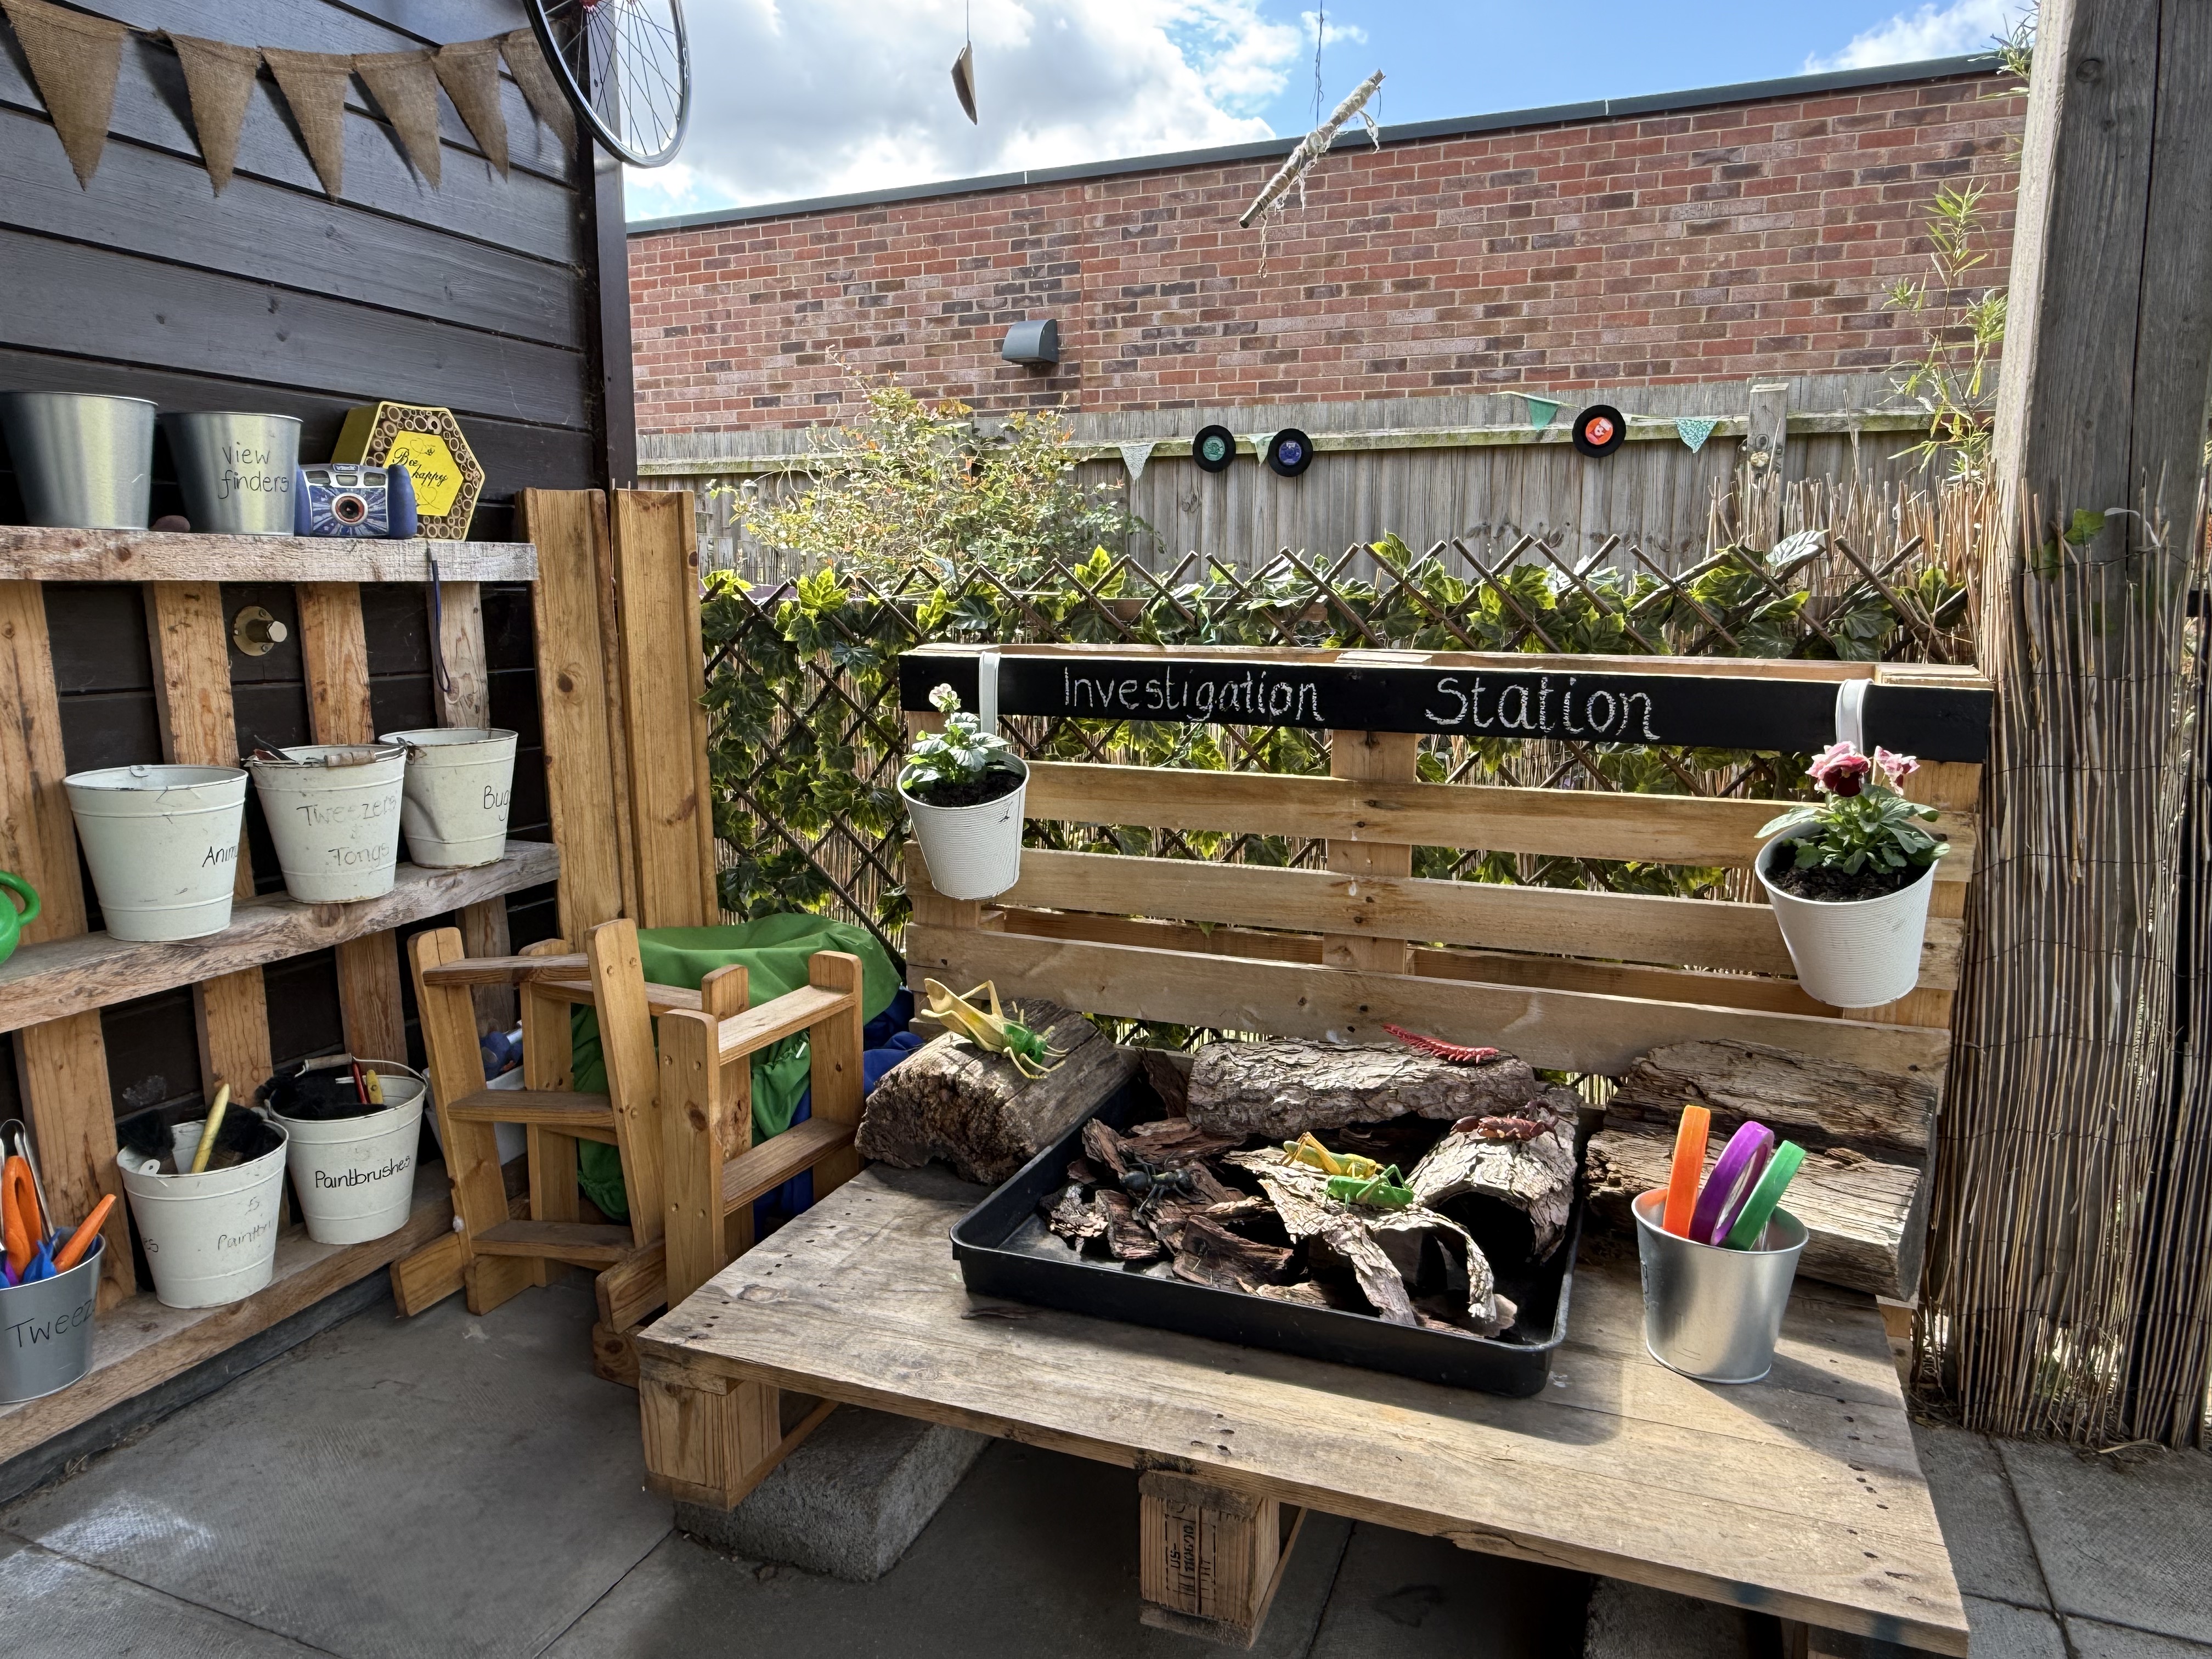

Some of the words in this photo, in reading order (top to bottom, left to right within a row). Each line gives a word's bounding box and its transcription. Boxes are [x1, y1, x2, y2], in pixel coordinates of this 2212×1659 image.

[218, 470, 289, 499] finders
[411, 464, 449, 487] happy
[1064, 665, 1325, 723] Investigation
[1425, 676, 1661, 741] Station
[296, 795, 397, 826] Tweezers
[483, 785, 510, 822] Bug
[201, 845, 238, 867] Anim
[328, 843, 390, 868] Tongs
[314, 1155, 411, 1189] Paintbrushes
